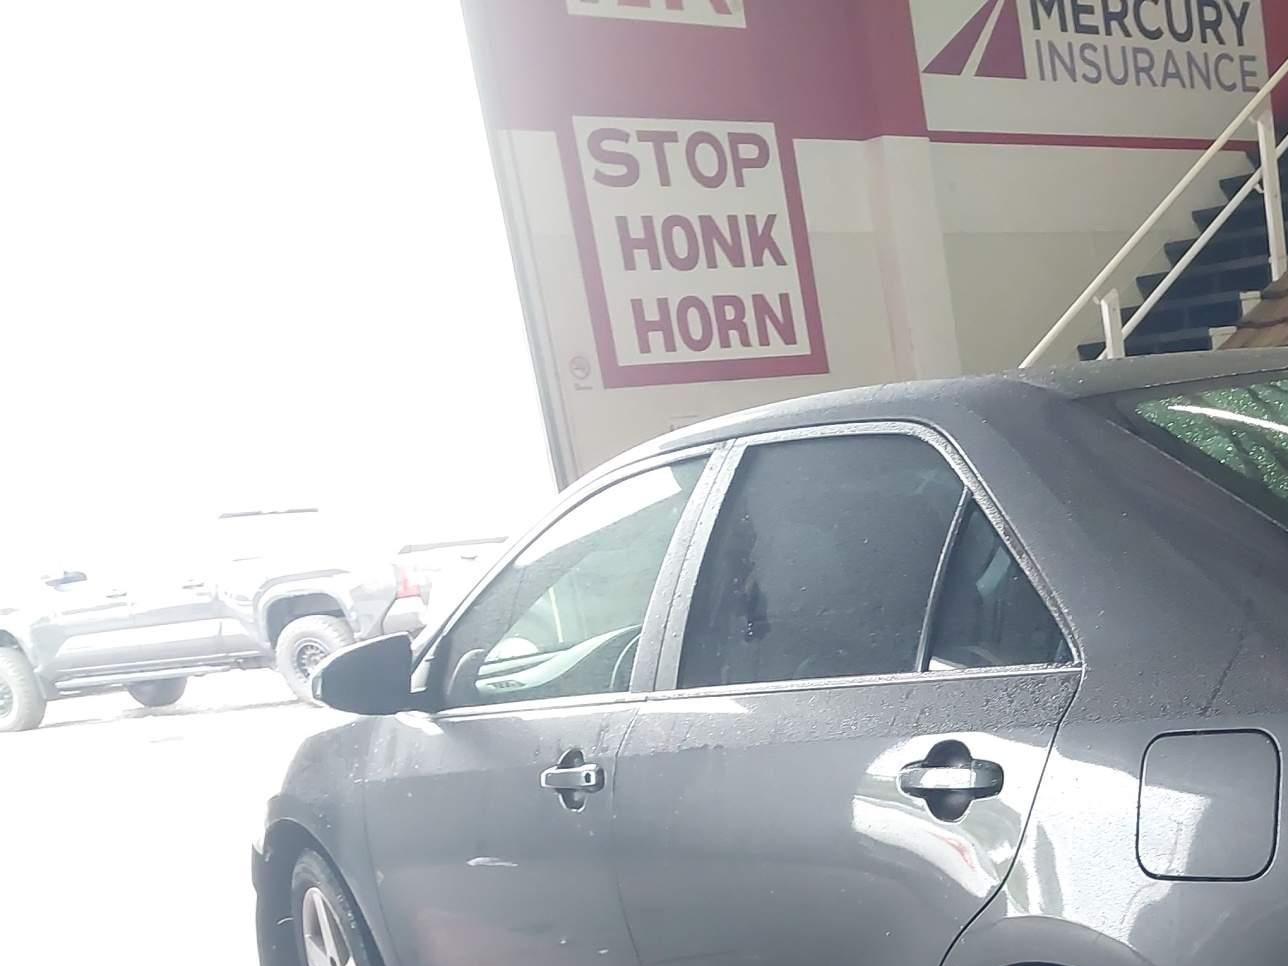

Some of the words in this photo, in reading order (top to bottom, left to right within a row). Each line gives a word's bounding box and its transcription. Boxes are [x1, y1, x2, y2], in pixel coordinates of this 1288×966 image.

[1029, 0, 1250, 46] MERCURY
[1034, 39, 1260, 93] INSURANCE
[587, 127, 770, 189] STOP
[614, 213, 788, 271] HONK
[630, 292, 798, 354] HORN
